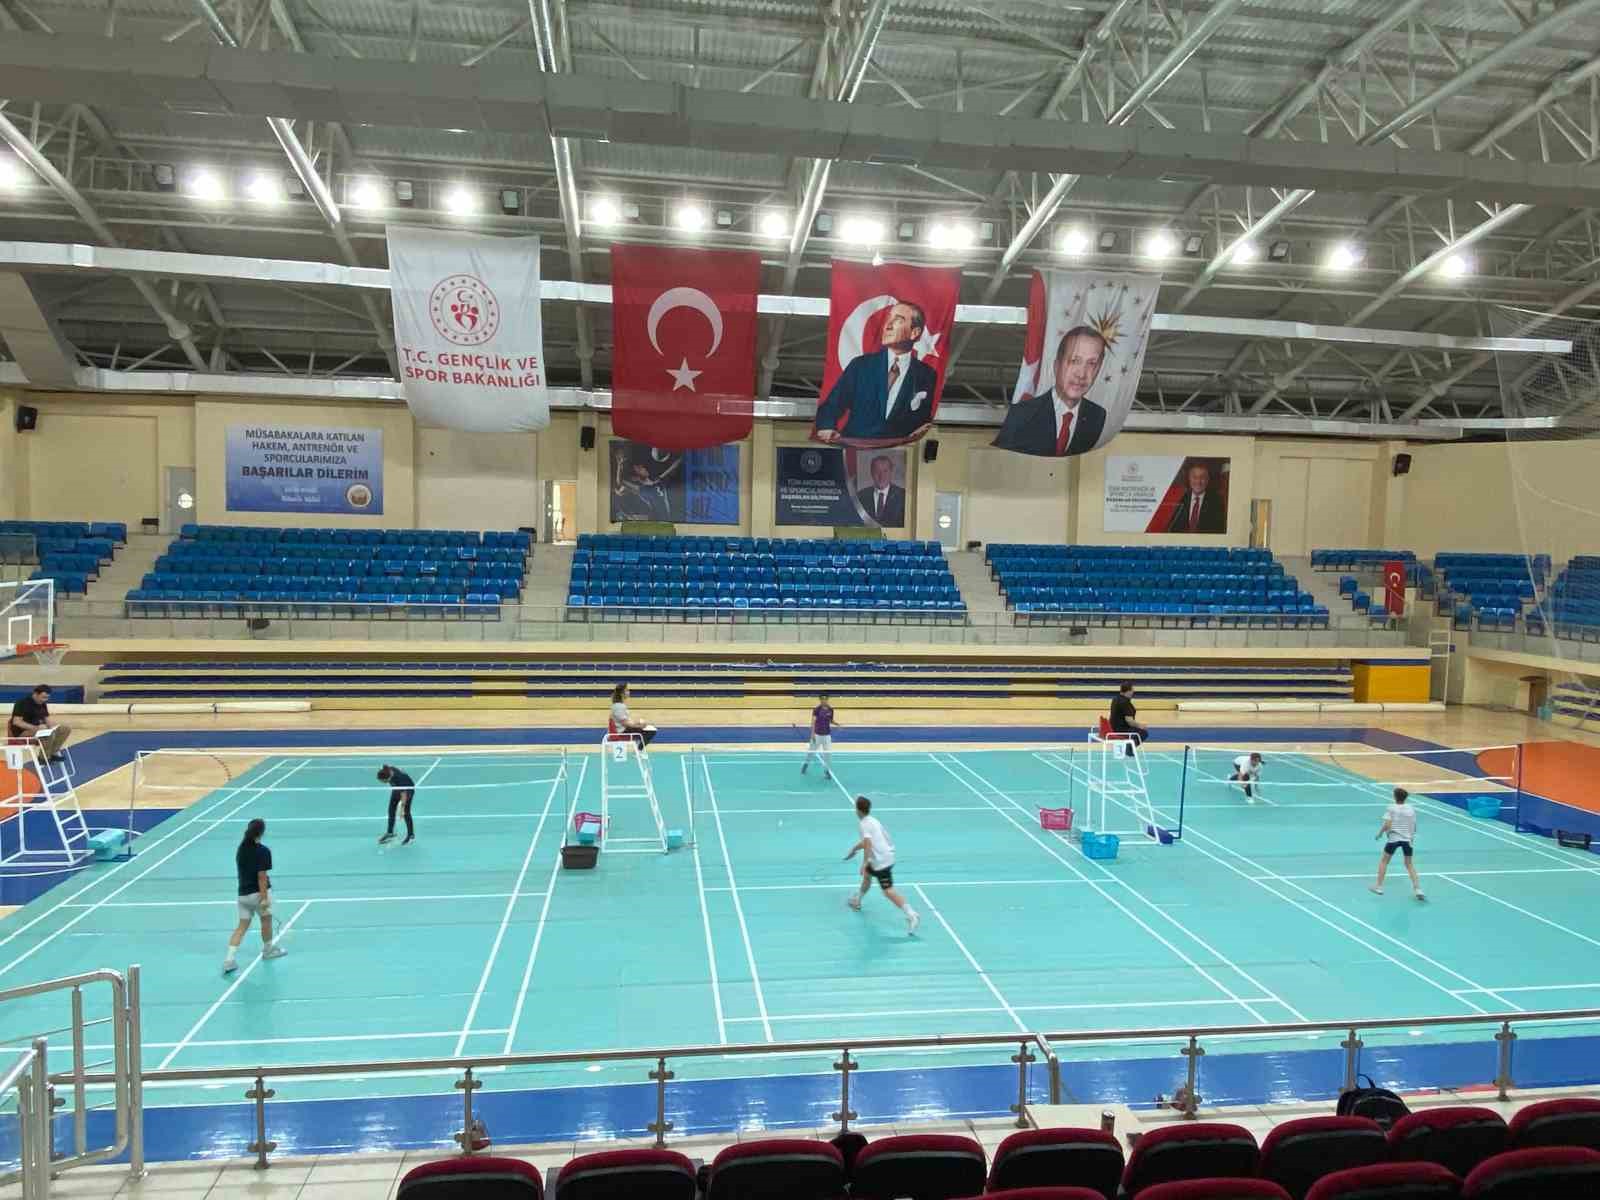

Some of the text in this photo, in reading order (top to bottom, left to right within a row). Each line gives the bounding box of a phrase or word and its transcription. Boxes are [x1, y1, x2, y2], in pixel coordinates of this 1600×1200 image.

[402, 348, 538, 372] T.C. GENÇLİK VE
[405, 366, 540, 388] SPOR BAKANLIĞI
[245, 428, 365, 442] MÜSABAKALARA KATILAN
[252, 441, 358, 454] HAKEM, ANTRENÖR VE
[241, 466, 369, 481] BAŞARILAR DİLERİM
[615, 746, 624, 759] 2
